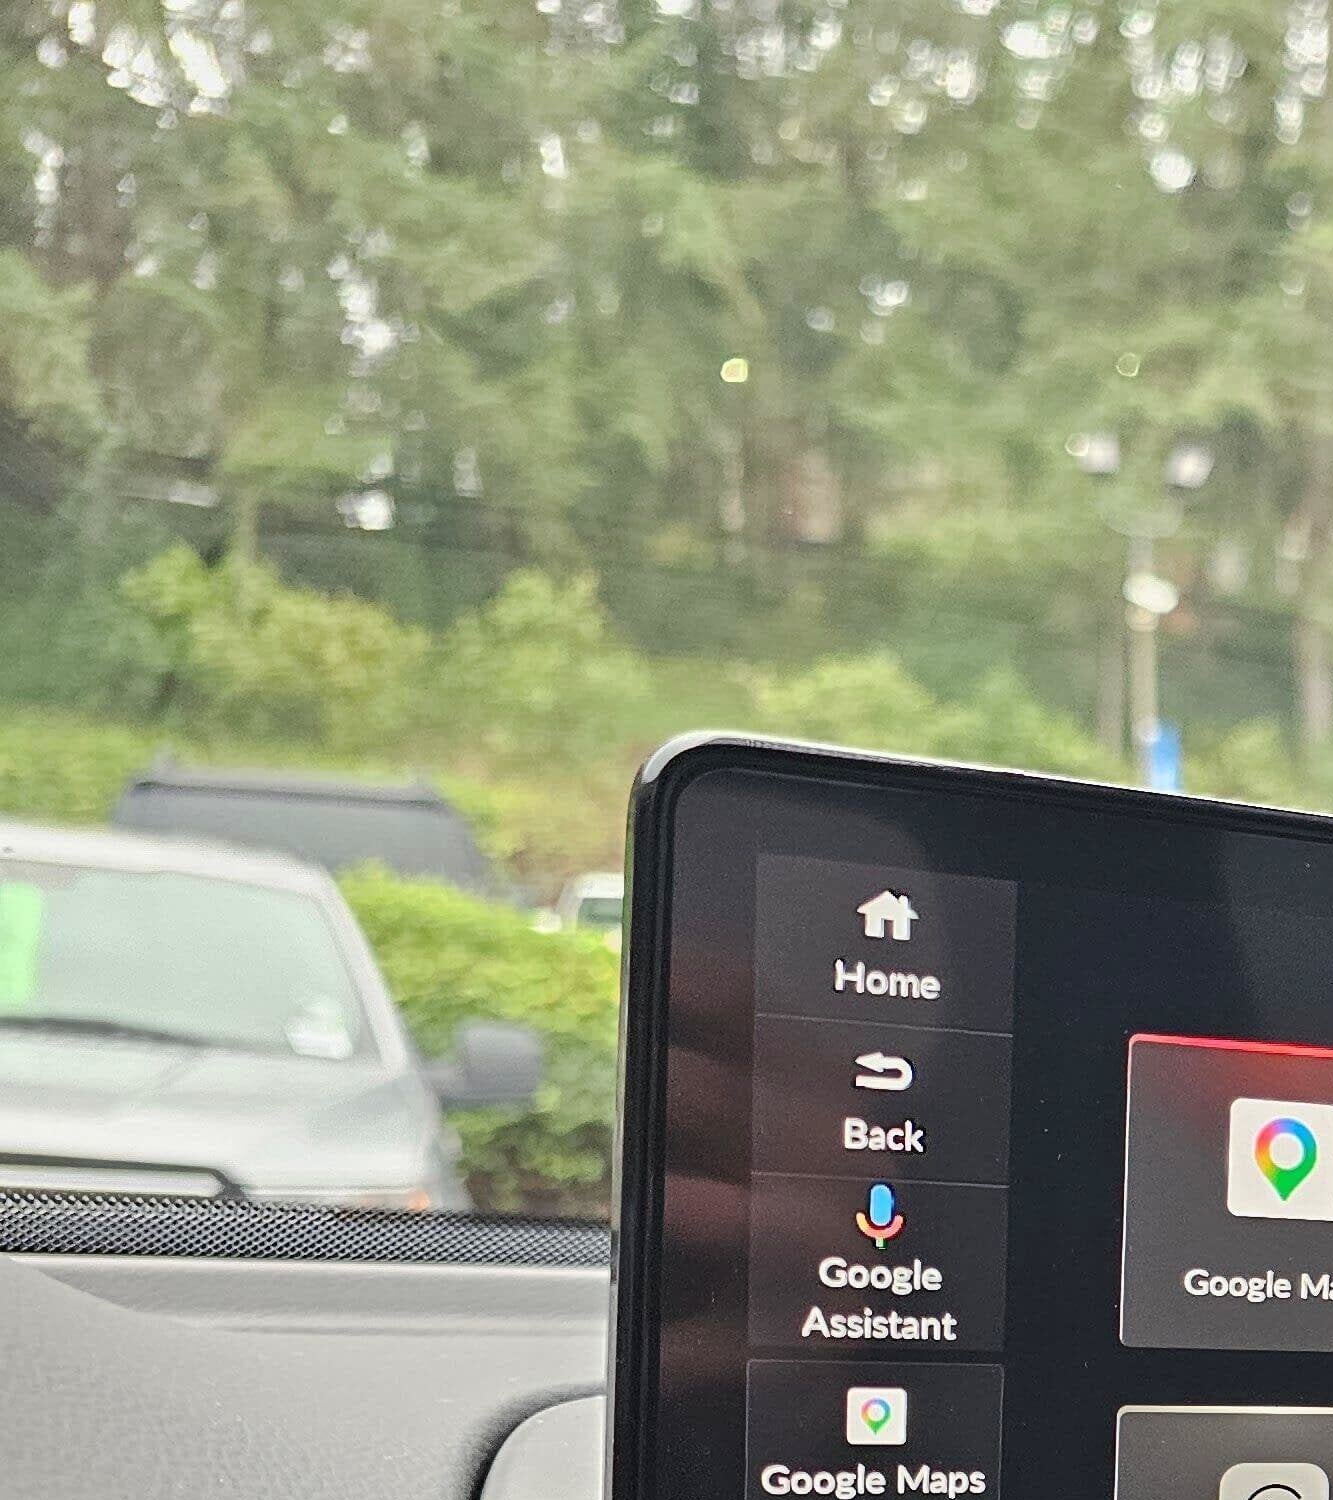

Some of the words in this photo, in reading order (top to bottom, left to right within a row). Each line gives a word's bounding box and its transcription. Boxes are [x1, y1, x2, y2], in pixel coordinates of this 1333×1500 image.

[833, 959, 941, 1000] Home
[844, 1119, 925, 1154] Back
[818, 1257, 943, 1295] Google
[1183, 1267, 1292, 1303] Google
[801, 1306, 958, 1342] Assistant
[761, 1464, 886, 1500] Google
[897, 1465, 987, 1499] Maps
